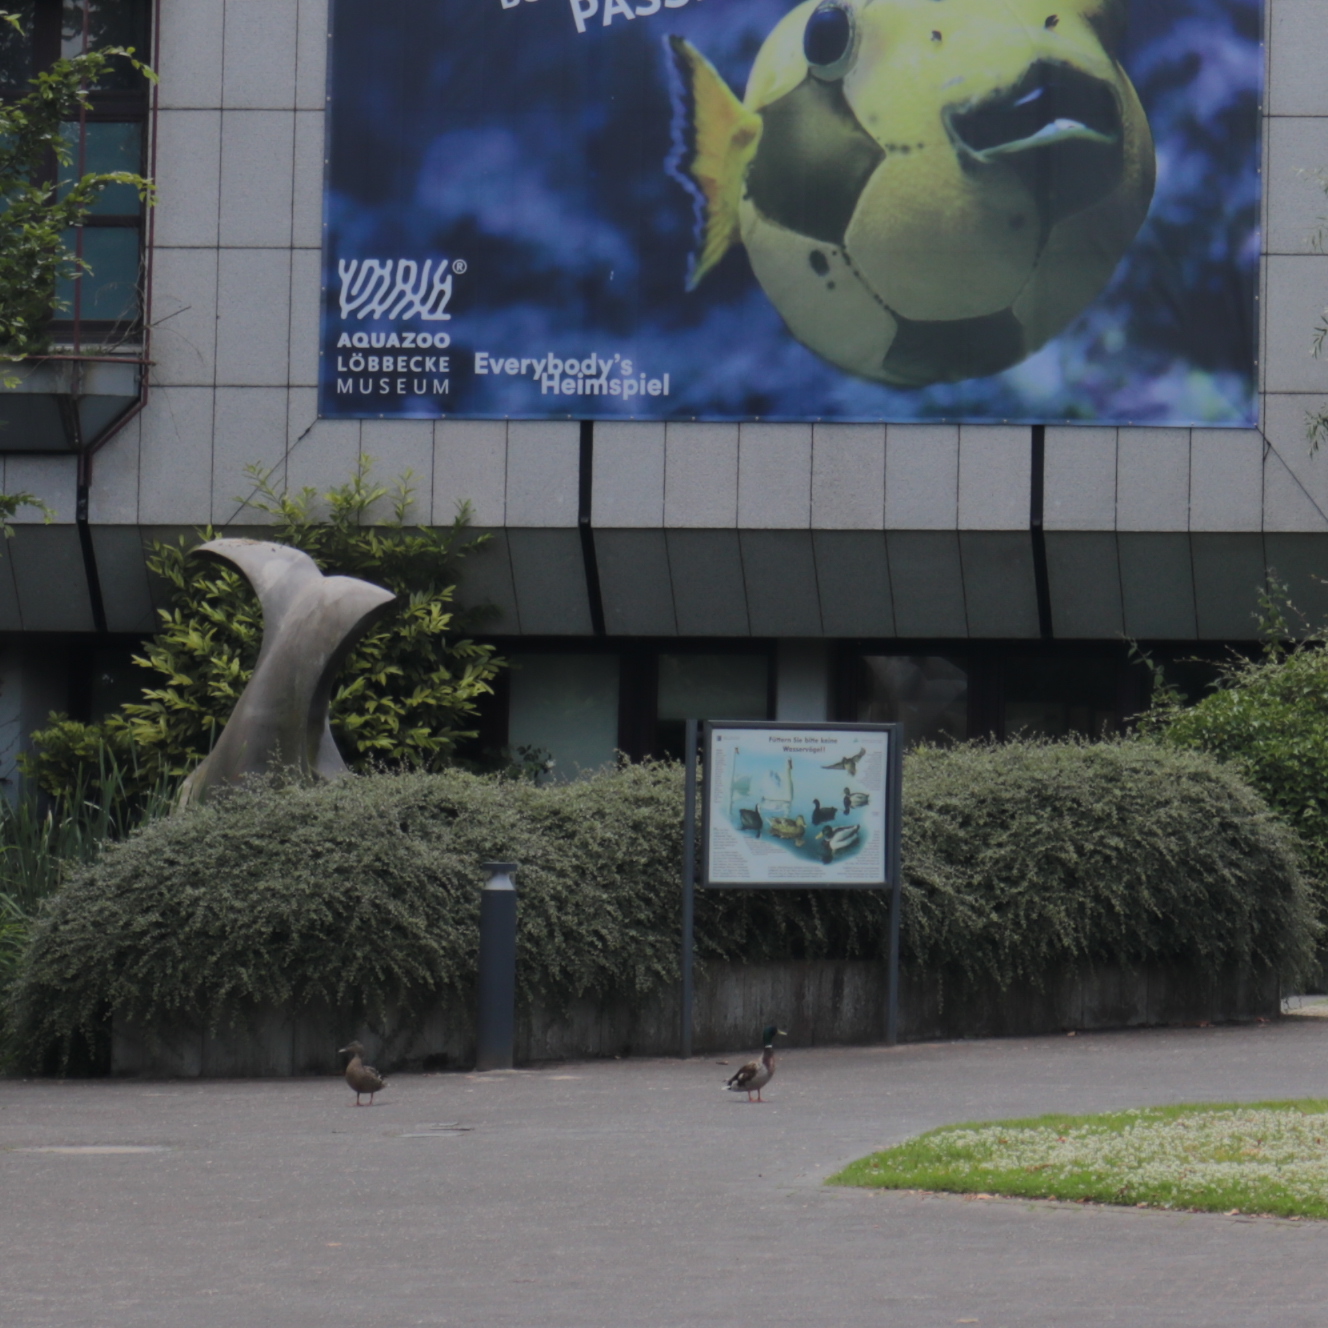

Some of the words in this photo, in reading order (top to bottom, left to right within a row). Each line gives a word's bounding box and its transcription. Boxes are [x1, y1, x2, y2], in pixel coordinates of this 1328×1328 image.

[337, 332, 450, 348] AQUAZOO
[338, 353, 450, 372] LÖBBECKE
[337, 378, 449, 394] MUSEUM
[541, 373, 669, 400] Heimspiel
